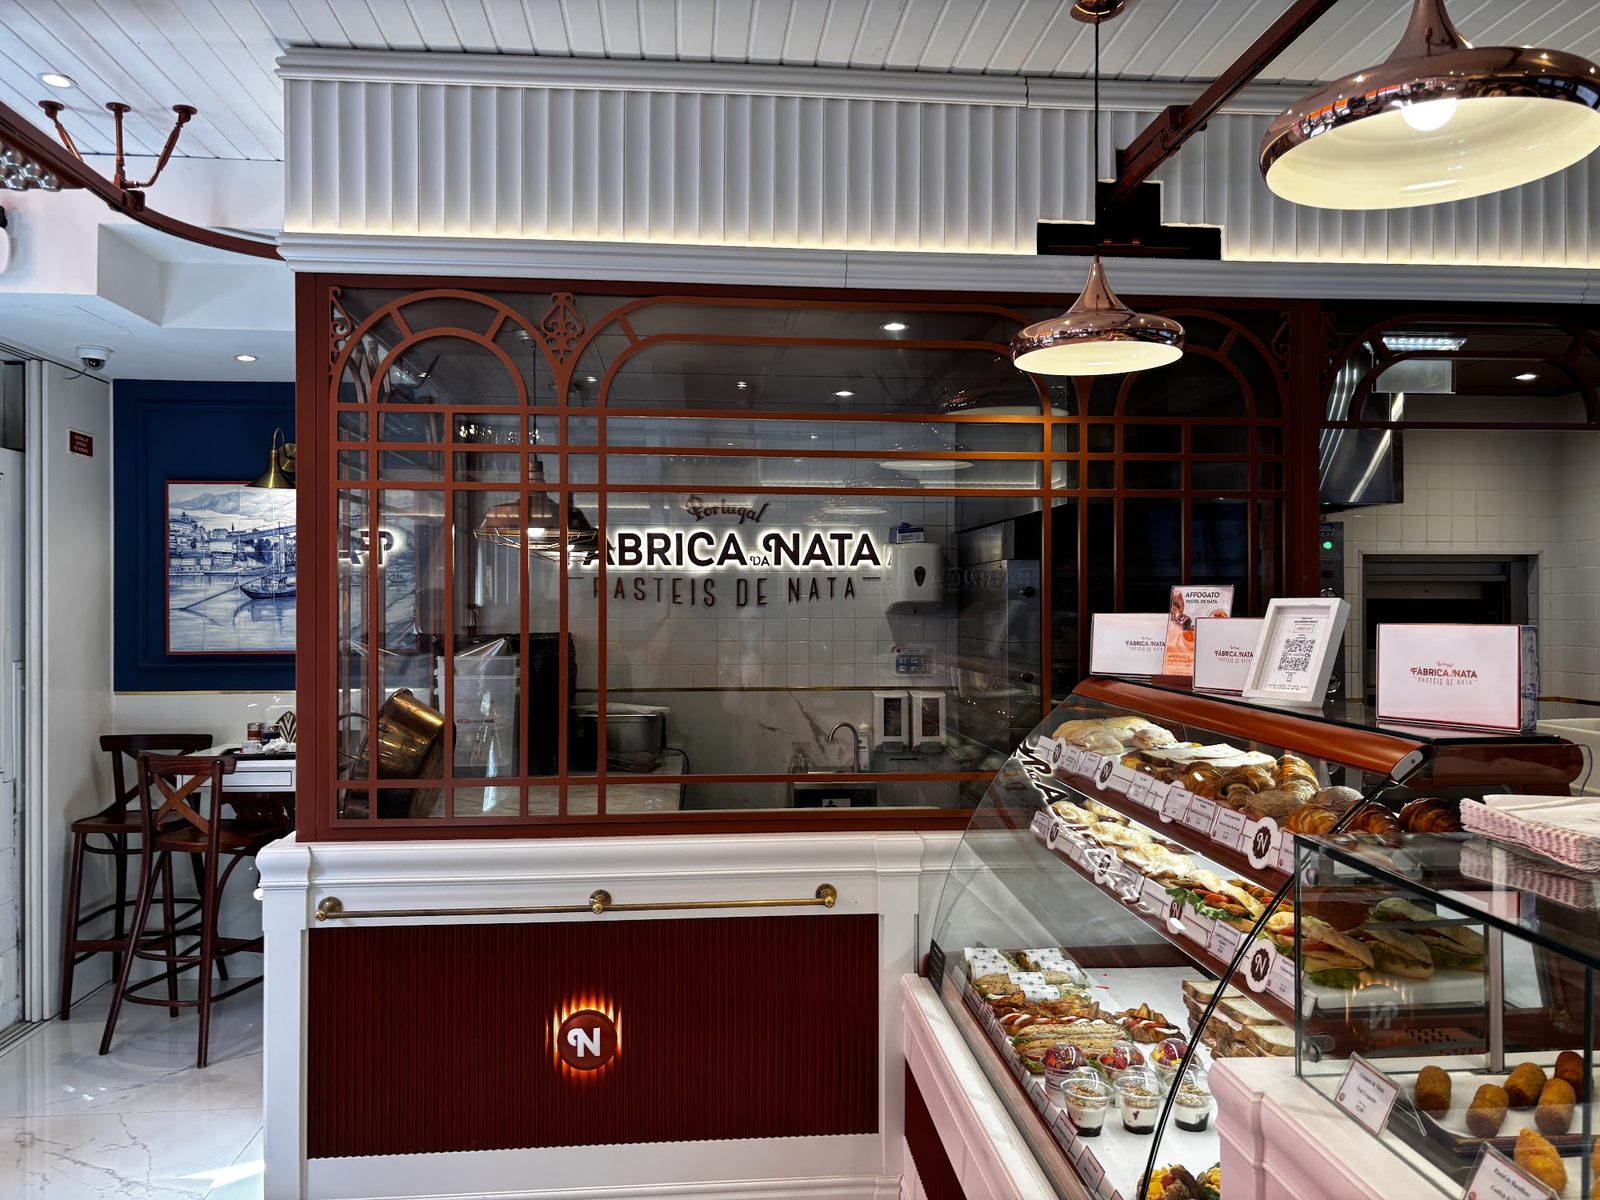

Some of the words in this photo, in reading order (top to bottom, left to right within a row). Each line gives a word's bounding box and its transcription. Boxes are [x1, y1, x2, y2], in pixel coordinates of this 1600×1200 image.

[686, 494, 769, 524] Portugal
[567, 532, 748, 567] ABRICA
[750, 556, 770, 567] DA
[762, 533, 881, 566] NATA
[736, 578, 768, 607] DE
[788, 577, 855, 603] NATA
[1452, 669, 1478, 679] NATA
[1256, 832, 1269, 855] N
[1254, 954, 1268, 976] N
[567, 1027, 600, 1057] N
